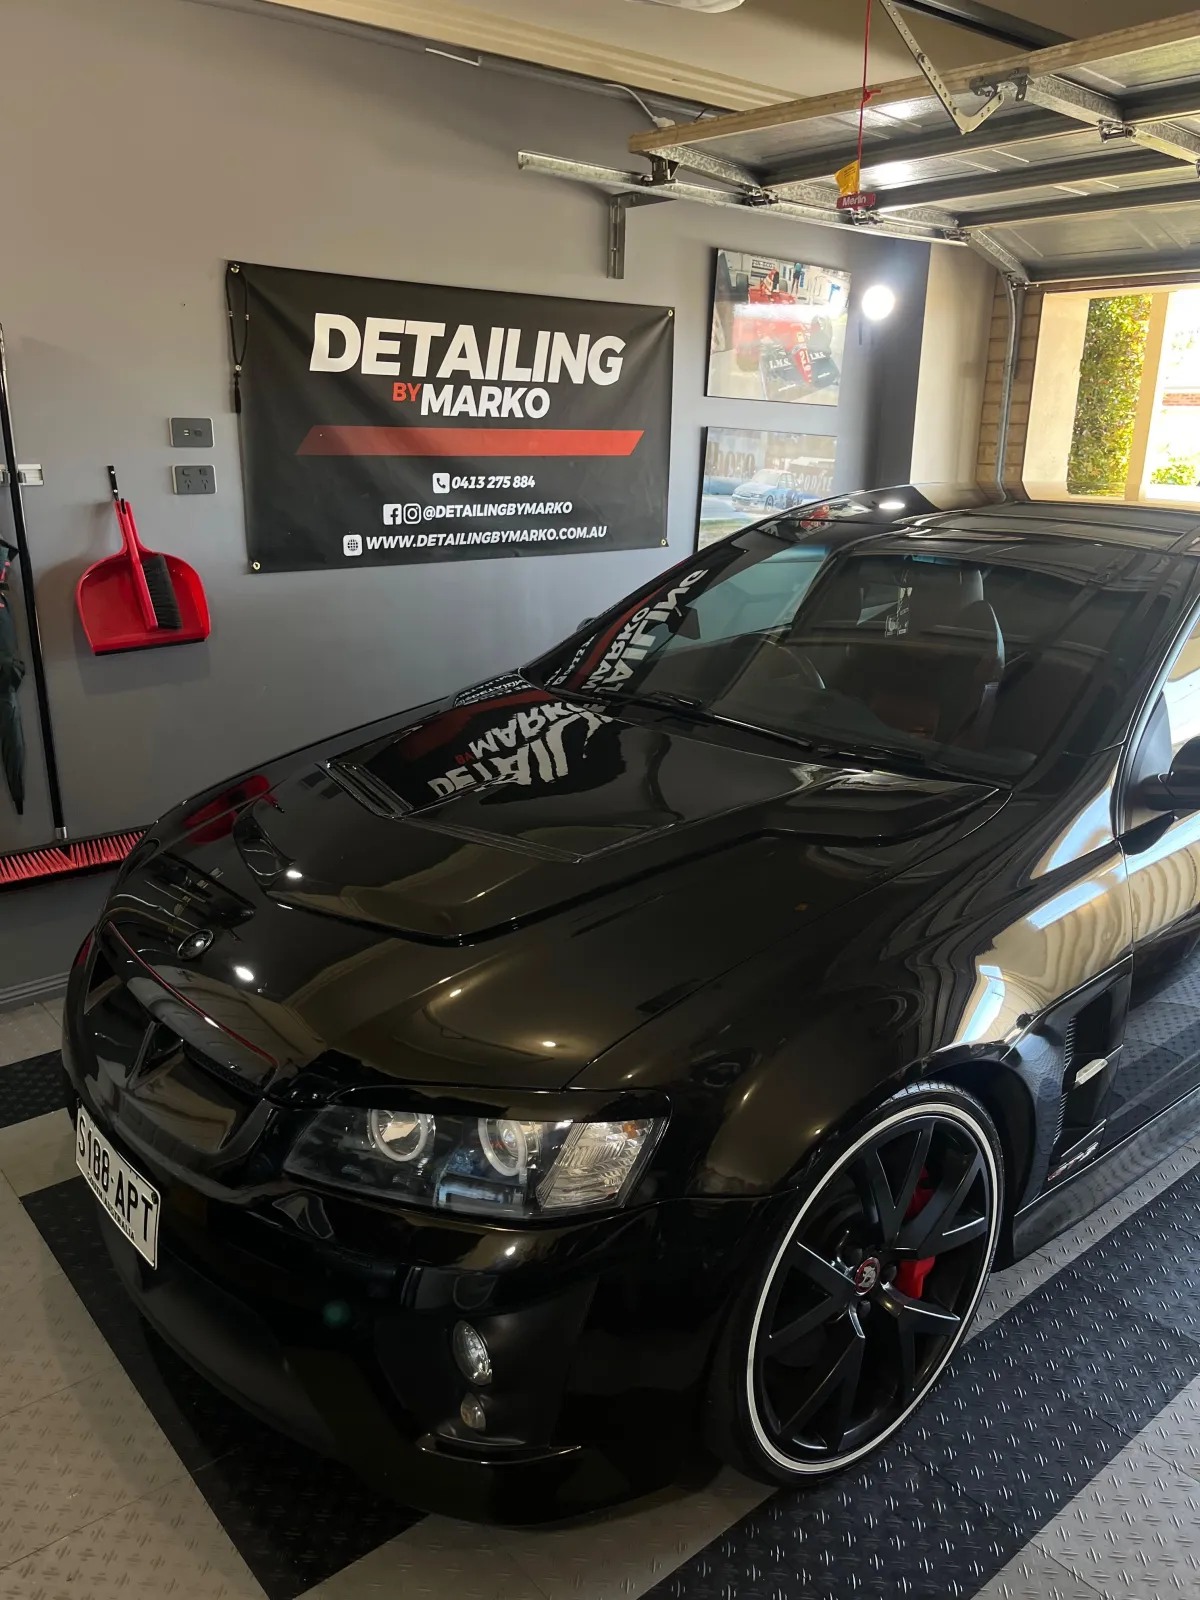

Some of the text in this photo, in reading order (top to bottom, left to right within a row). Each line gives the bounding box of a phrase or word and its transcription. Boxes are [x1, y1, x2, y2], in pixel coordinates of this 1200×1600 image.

[842, 195, 867, 206] Merlin
[308, 312, 626, 386] DETAILING
[392, 382, 550, 419] BY MARKO
[451, 475, 536, 490] 0413 275 884
[423, 501, 573, 521] @DETAILINGBYMARKO
[366, 525, 607, 550] WWW.DETAILINGBYMARKO.COM.AU
